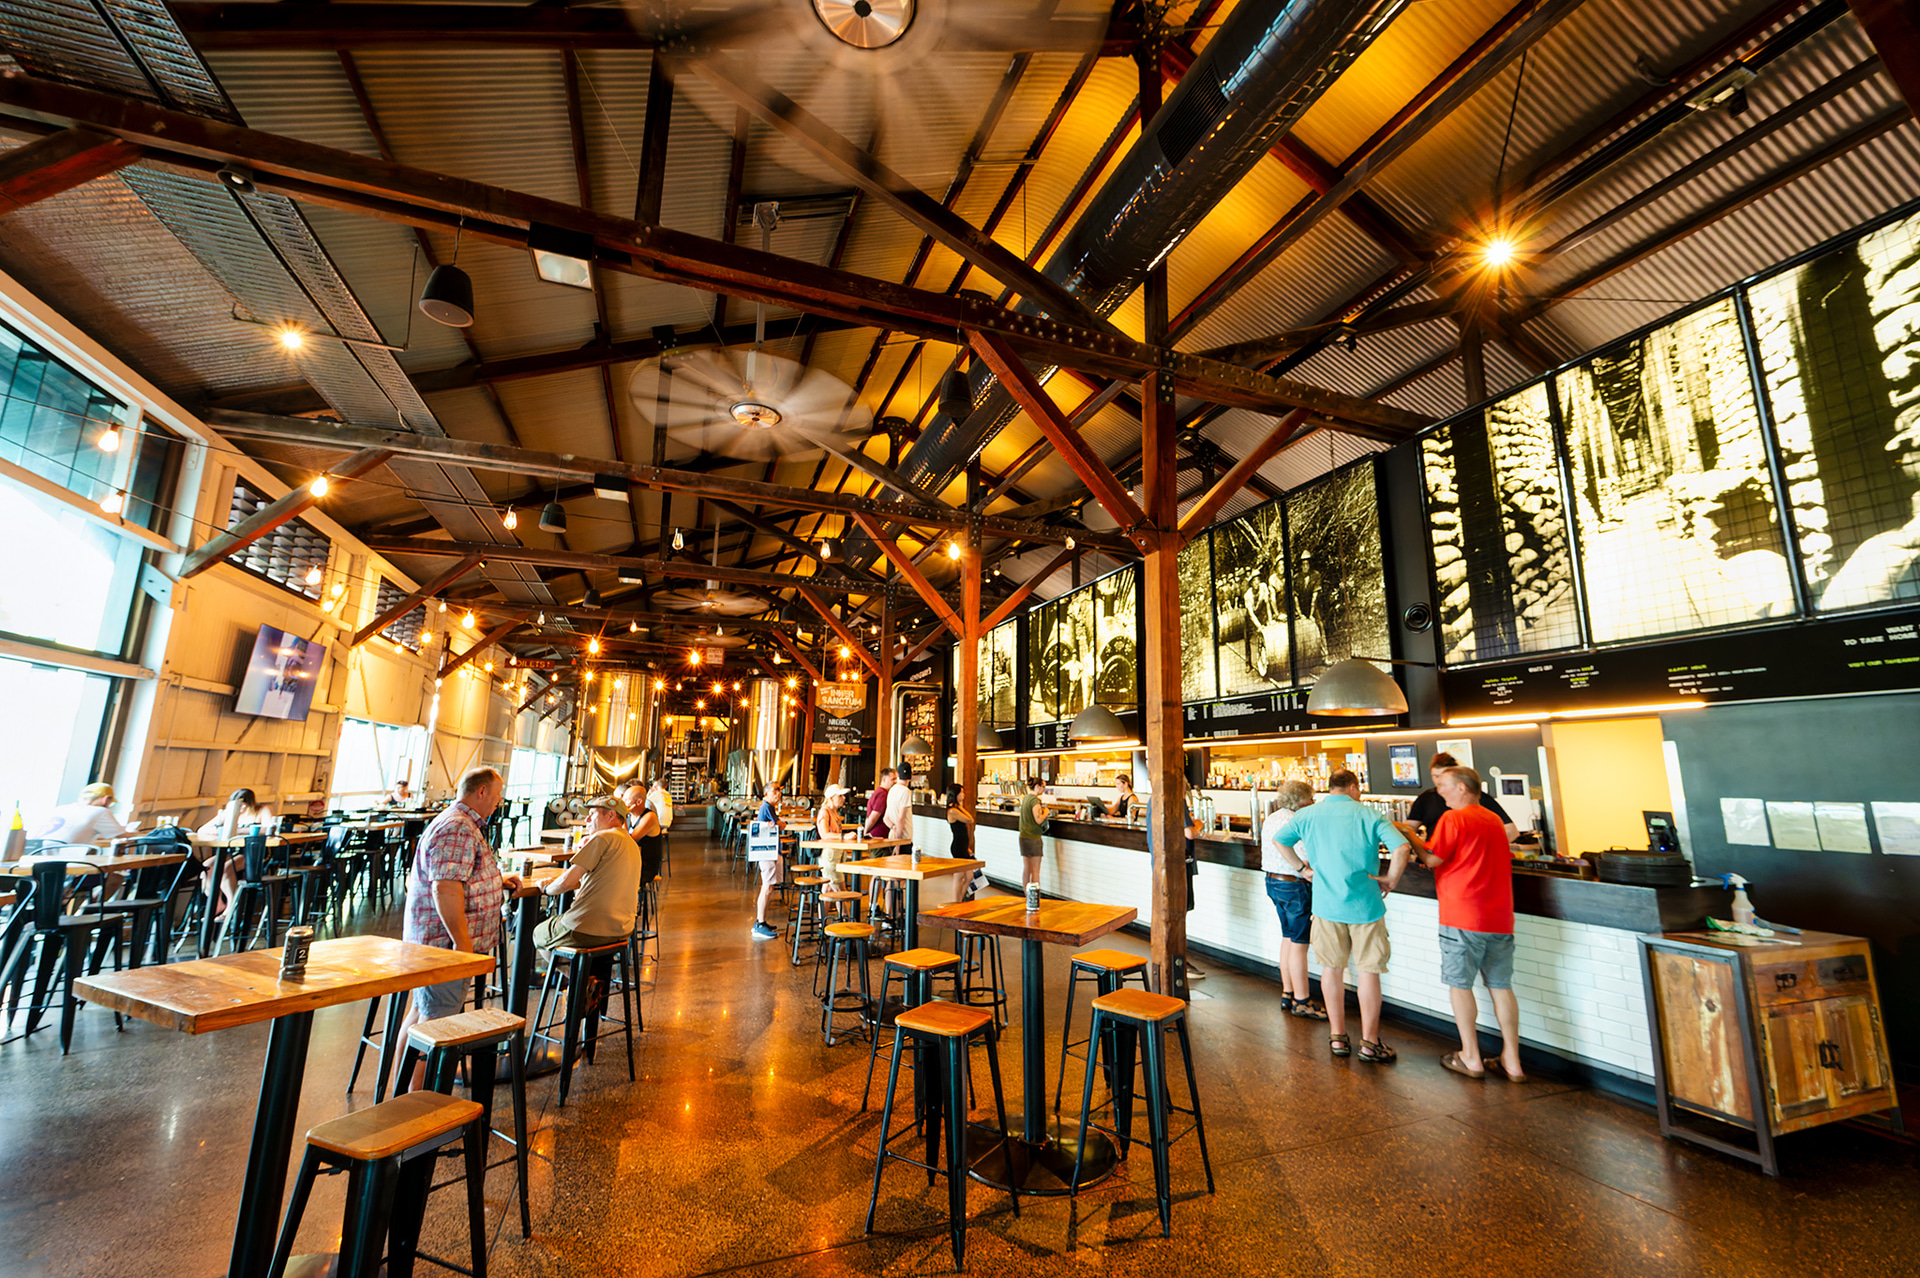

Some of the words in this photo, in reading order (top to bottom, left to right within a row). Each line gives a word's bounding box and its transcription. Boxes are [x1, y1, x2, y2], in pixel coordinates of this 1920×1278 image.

[1843, 638, 1858, 646] TO
[1859, 635, 1885, 645] TAKE
[822, 696, 862, 706] SANCTUM
